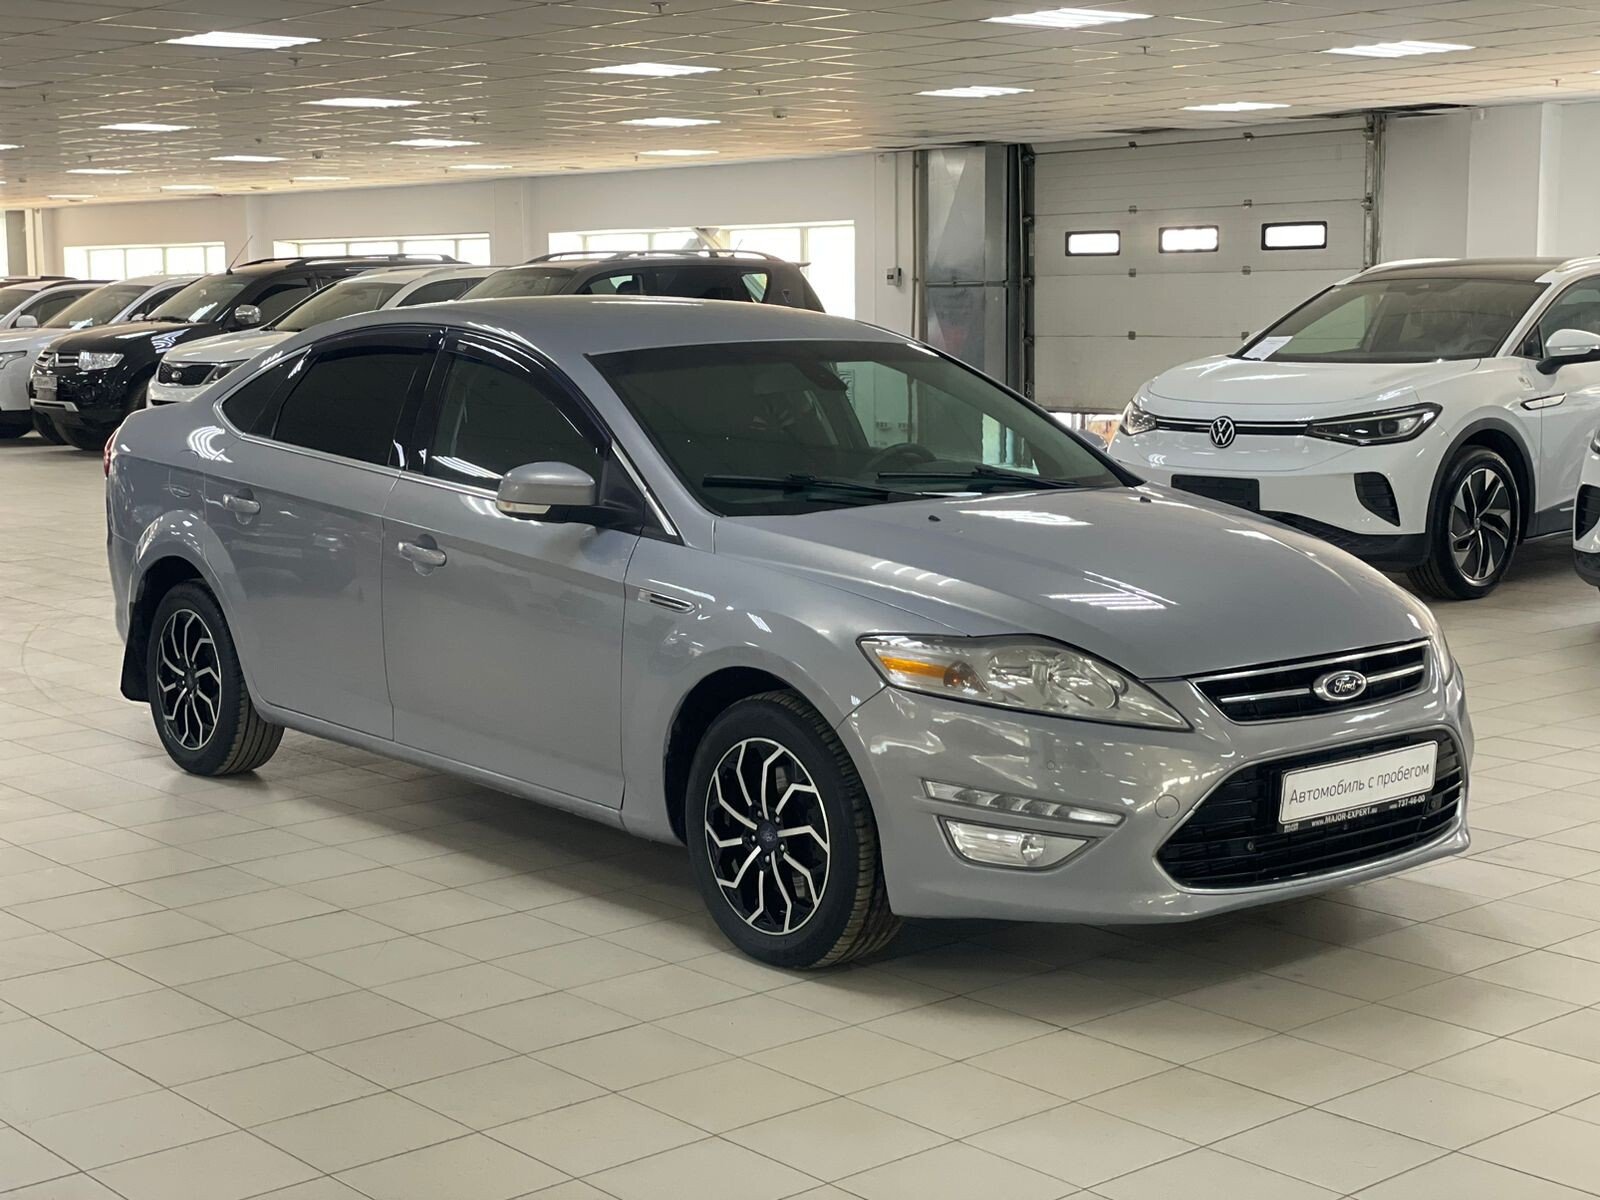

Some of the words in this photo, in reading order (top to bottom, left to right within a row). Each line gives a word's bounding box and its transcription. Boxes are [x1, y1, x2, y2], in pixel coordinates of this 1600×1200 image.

[1211, 418, 1234, 444] VW
[1334, 678, 1356, 693] Ford
[1289, 780, 1365, 805] Автомобиль
[1368, 776, 1374, 788] с
[1377, 763, 1430, 789] пробегом
